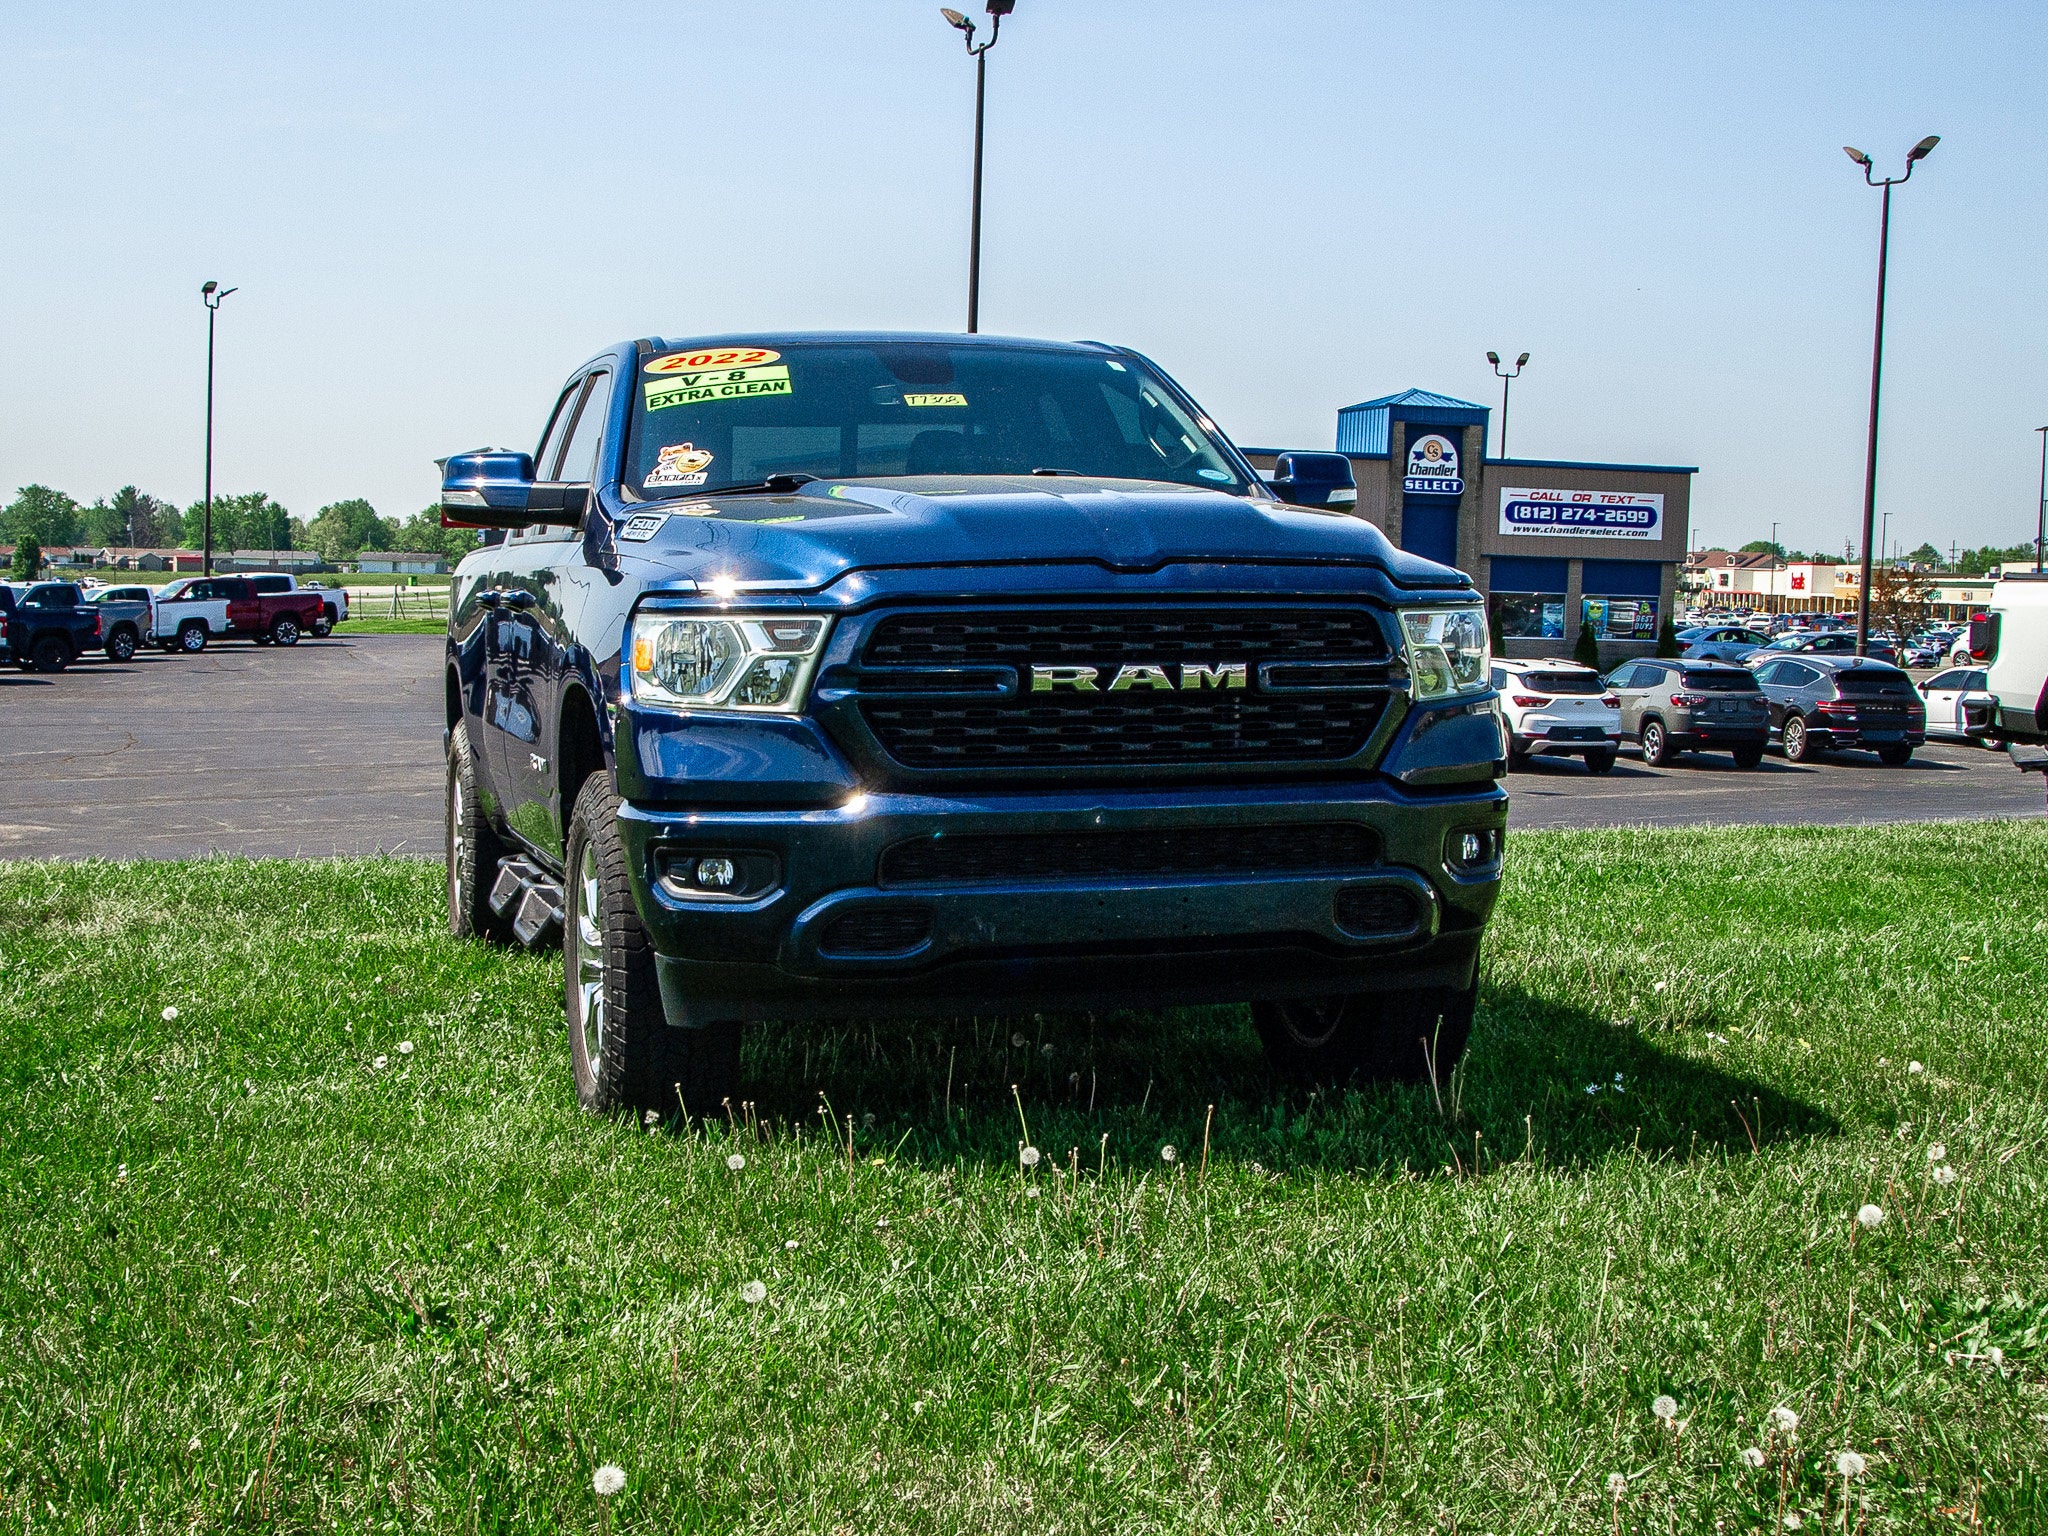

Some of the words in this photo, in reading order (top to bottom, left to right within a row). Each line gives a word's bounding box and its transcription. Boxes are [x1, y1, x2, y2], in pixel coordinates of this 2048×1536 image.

[660, 351, 767, 371] 2022
[650, 388, 714, 408] EXTRA
[720, 381, 786, 396] CLEAN
[1409, 463, 1457, 476] Chandler
[1405, 480, 1460, 490] SELECT
[1529, 492, 1563, 502] CALL
[1571, 493, 1592, 503] OR
[1600, 494, 1635, 504] TEXT
[1514, 505, 1557, 521] (812)
[1561, 507, 1649, 523] 274-2699
[630, 518, 660, 530] 1500
[1512, 525, 1649, 537] www.chandlerselect.com
[1031, 663, 1247, 691] RAM
